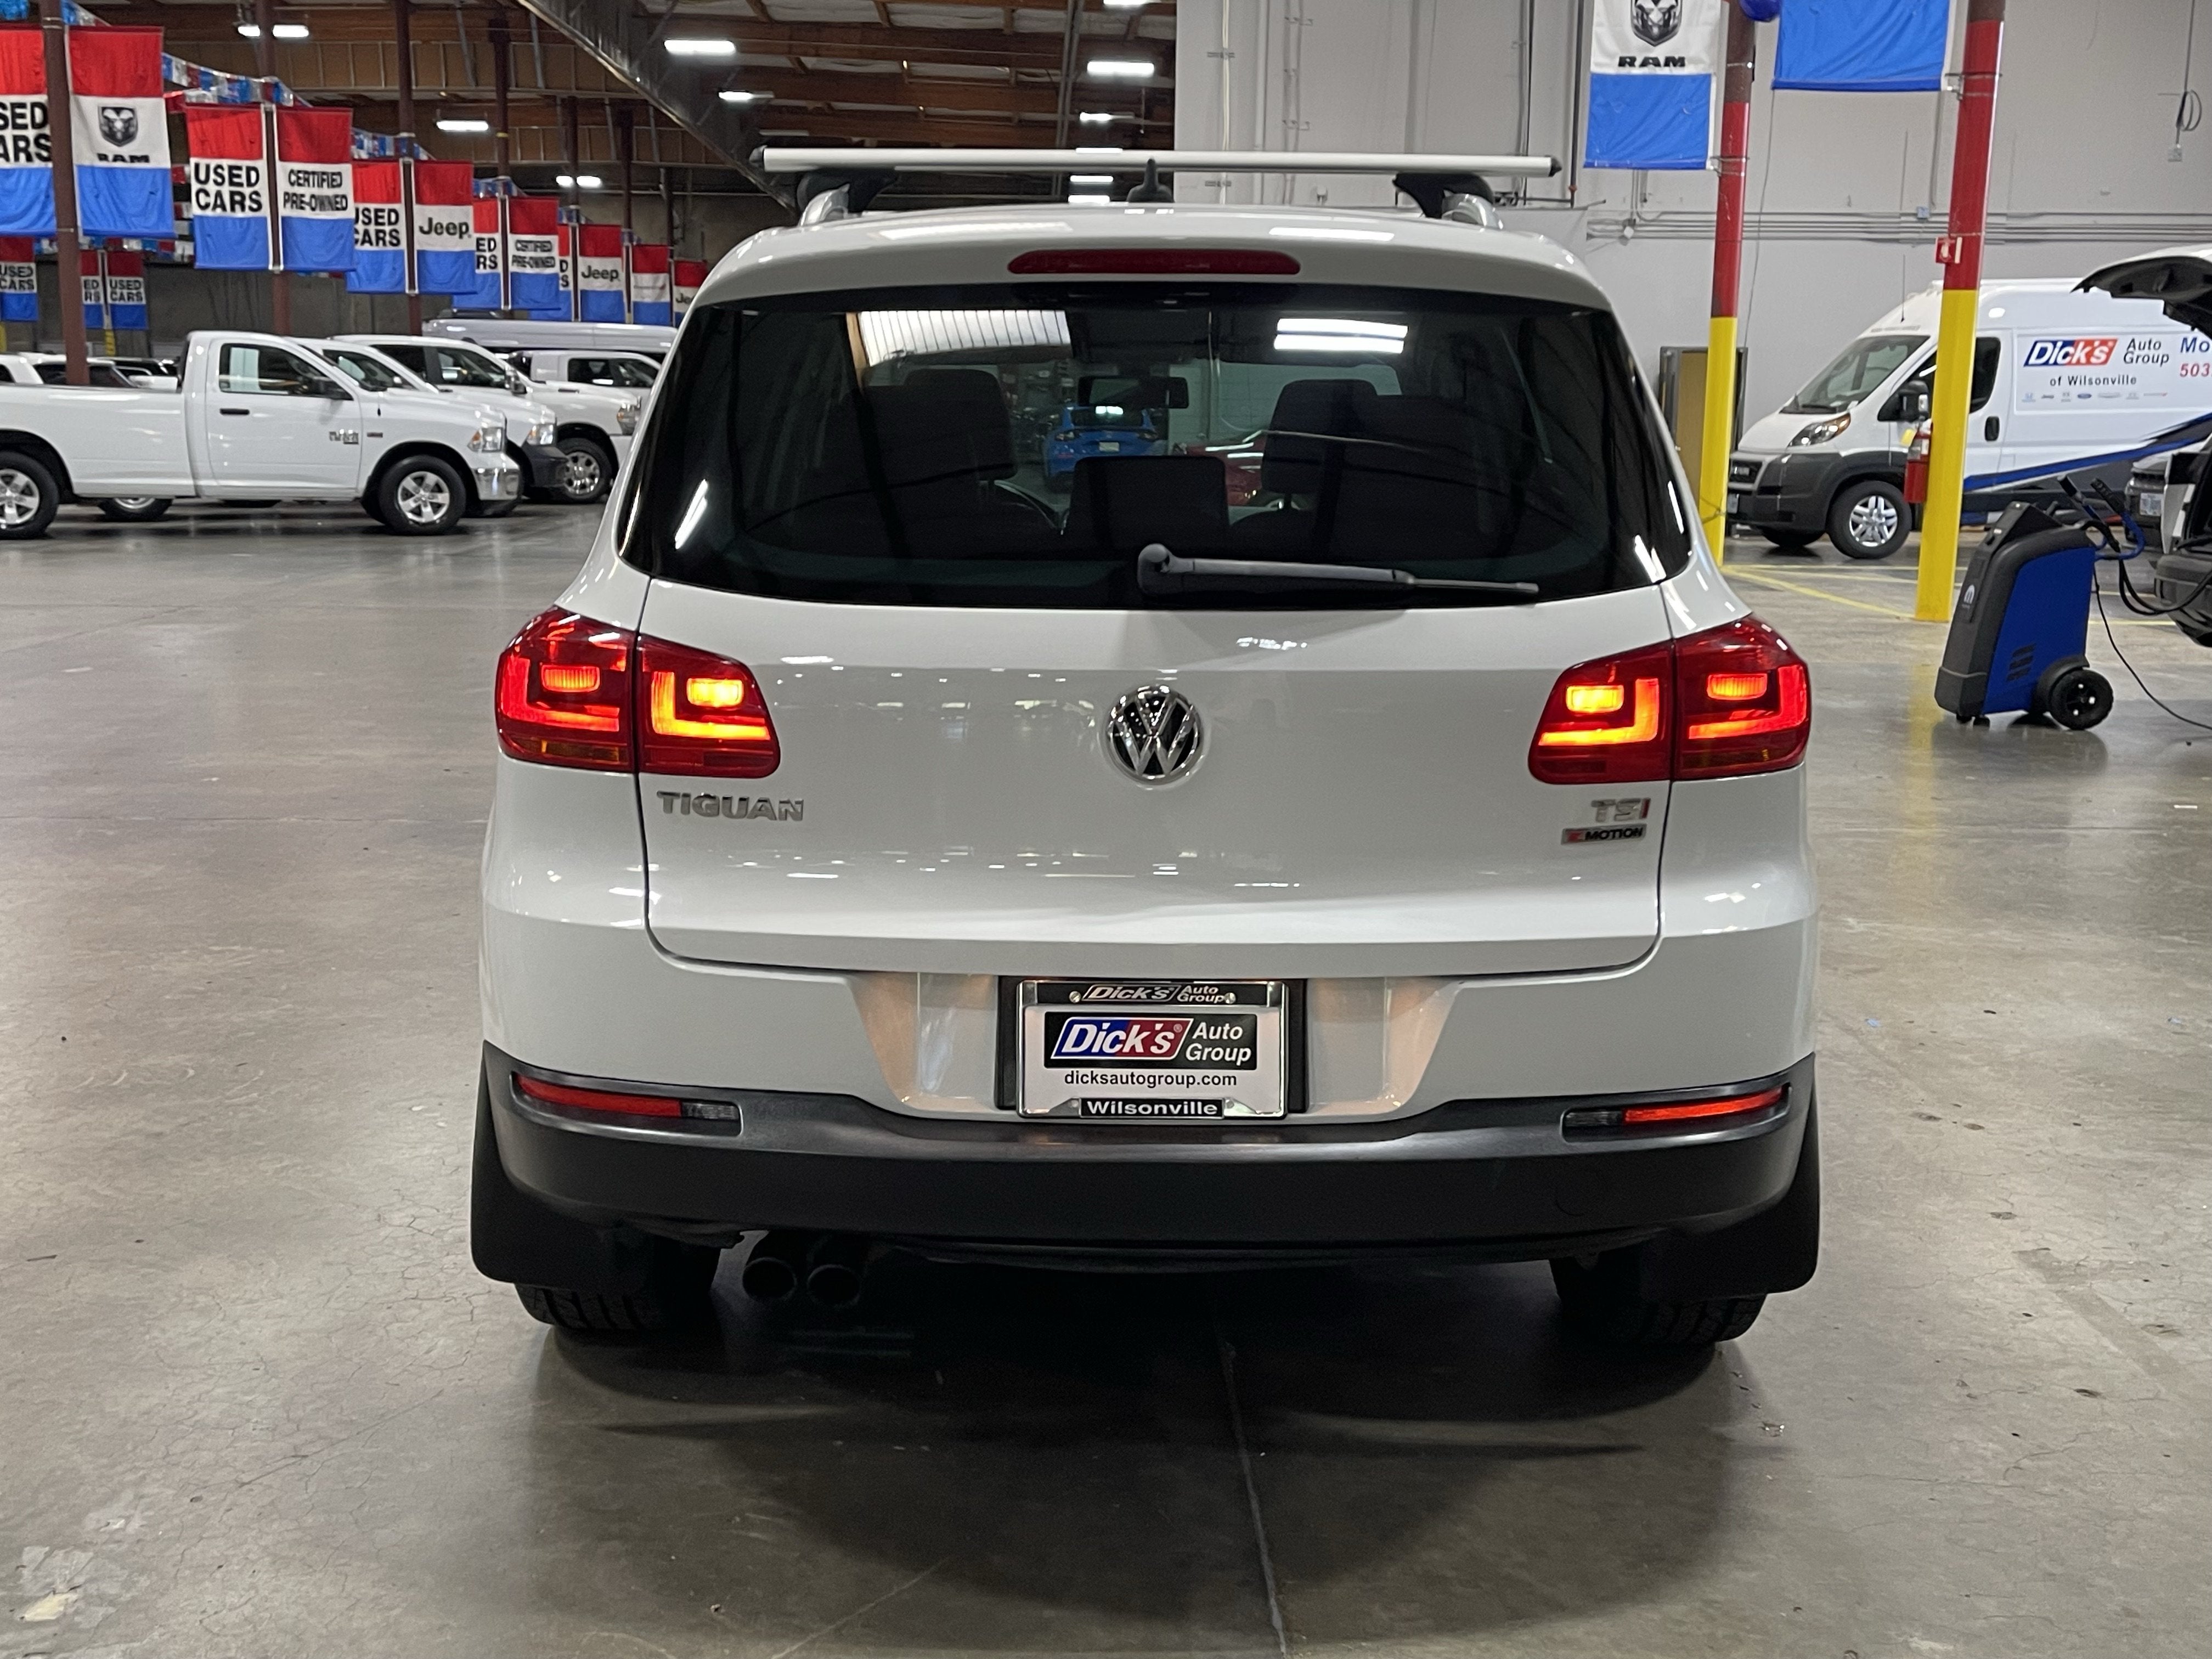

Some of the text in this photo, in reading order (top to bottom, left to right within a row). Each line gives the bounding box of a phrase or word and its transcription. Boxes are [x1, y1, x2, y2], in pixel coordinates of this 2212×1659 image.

[1618, 56, 1686, 67] RAM
[97, 153, 150, 163] RAM
[194, 162, 259, 188] USED
[288, 169, 343, 189] CERTIFIED
[195, 188, 263, 213] CARS
[283, 191, 348, 212] PRE-OWNED
[354, 207, 399, 226] SED
[419, 217, 470, 239] Jeep
[476, 237, 496, 252] ED
[476, 254, 498, 270] RS
[581, 265, 619, 282] Jeep
[84, 280, 99, 289] ED
[110, 279, 142, 290] USED
[110, 291, 143, 301] CARS
[2126, 338, 2162, 351] Auto
[2029, 341, 2109, 365] Dick's
[2123, 351, 2170, 367] Group
[2050, 375, 2137, 386] of Wilsonville
[657, 791, 804, 822] TIGUAN
[1087, 986, 1170, 1000] Dick's
[1181, 985, 1219, 994] Auto
[1177, 994, 1225, 1004] Group
[1061, 1022, 1175, 1054] Dick's
[1192, 1022, 1244, 1040] Auto
[1186, 1043, 1252, 1066] Group
[1064, 1071, 1237, 1088] dicksautogroup.com
[1087, 1101, 1218, 1115] Wilsonville
